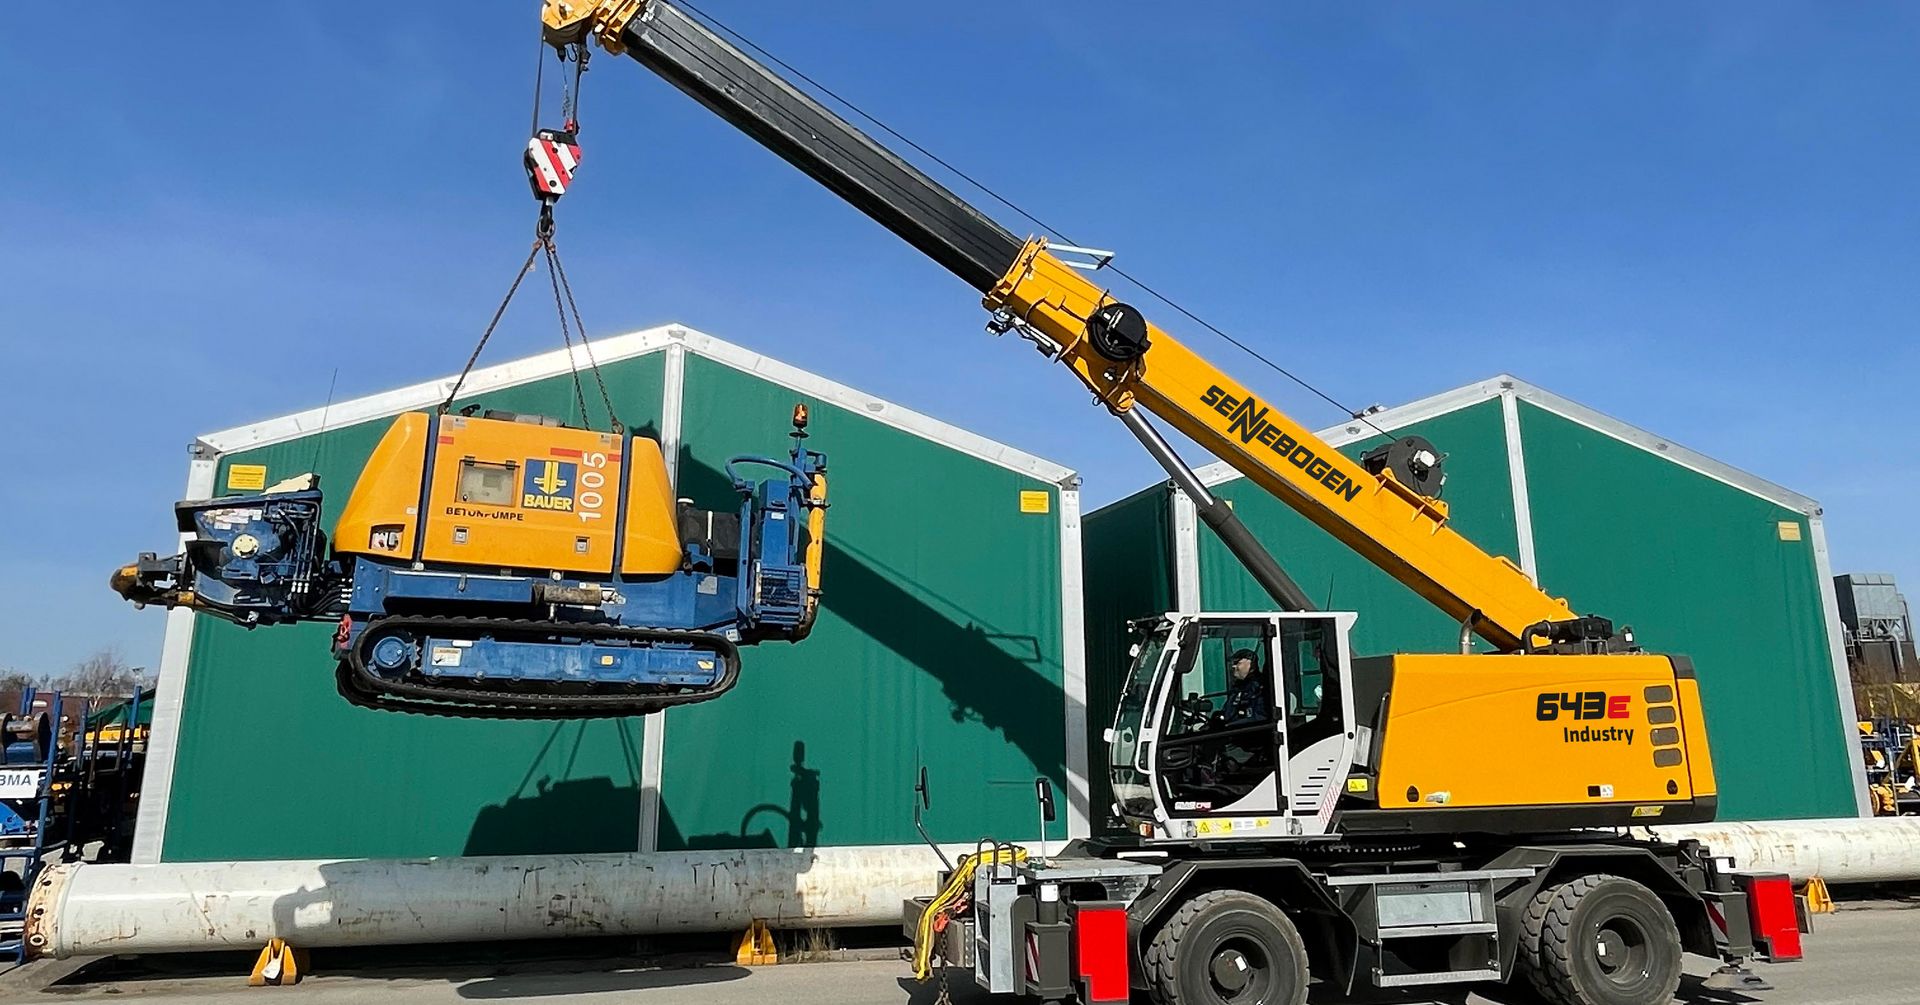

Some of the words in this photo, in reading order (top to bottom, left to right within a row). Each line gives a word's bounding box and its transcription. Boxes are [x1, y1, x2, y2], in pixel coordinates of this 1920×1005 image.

[1200, 385, 1363, 502] SENNEBOGEN
[523, 493, 573, 511] BAUER
[578, 451, 607, 523] 1005
[1536, 691, 1632, 721] 643E
[1563, 725, 1634, 745] Industry
